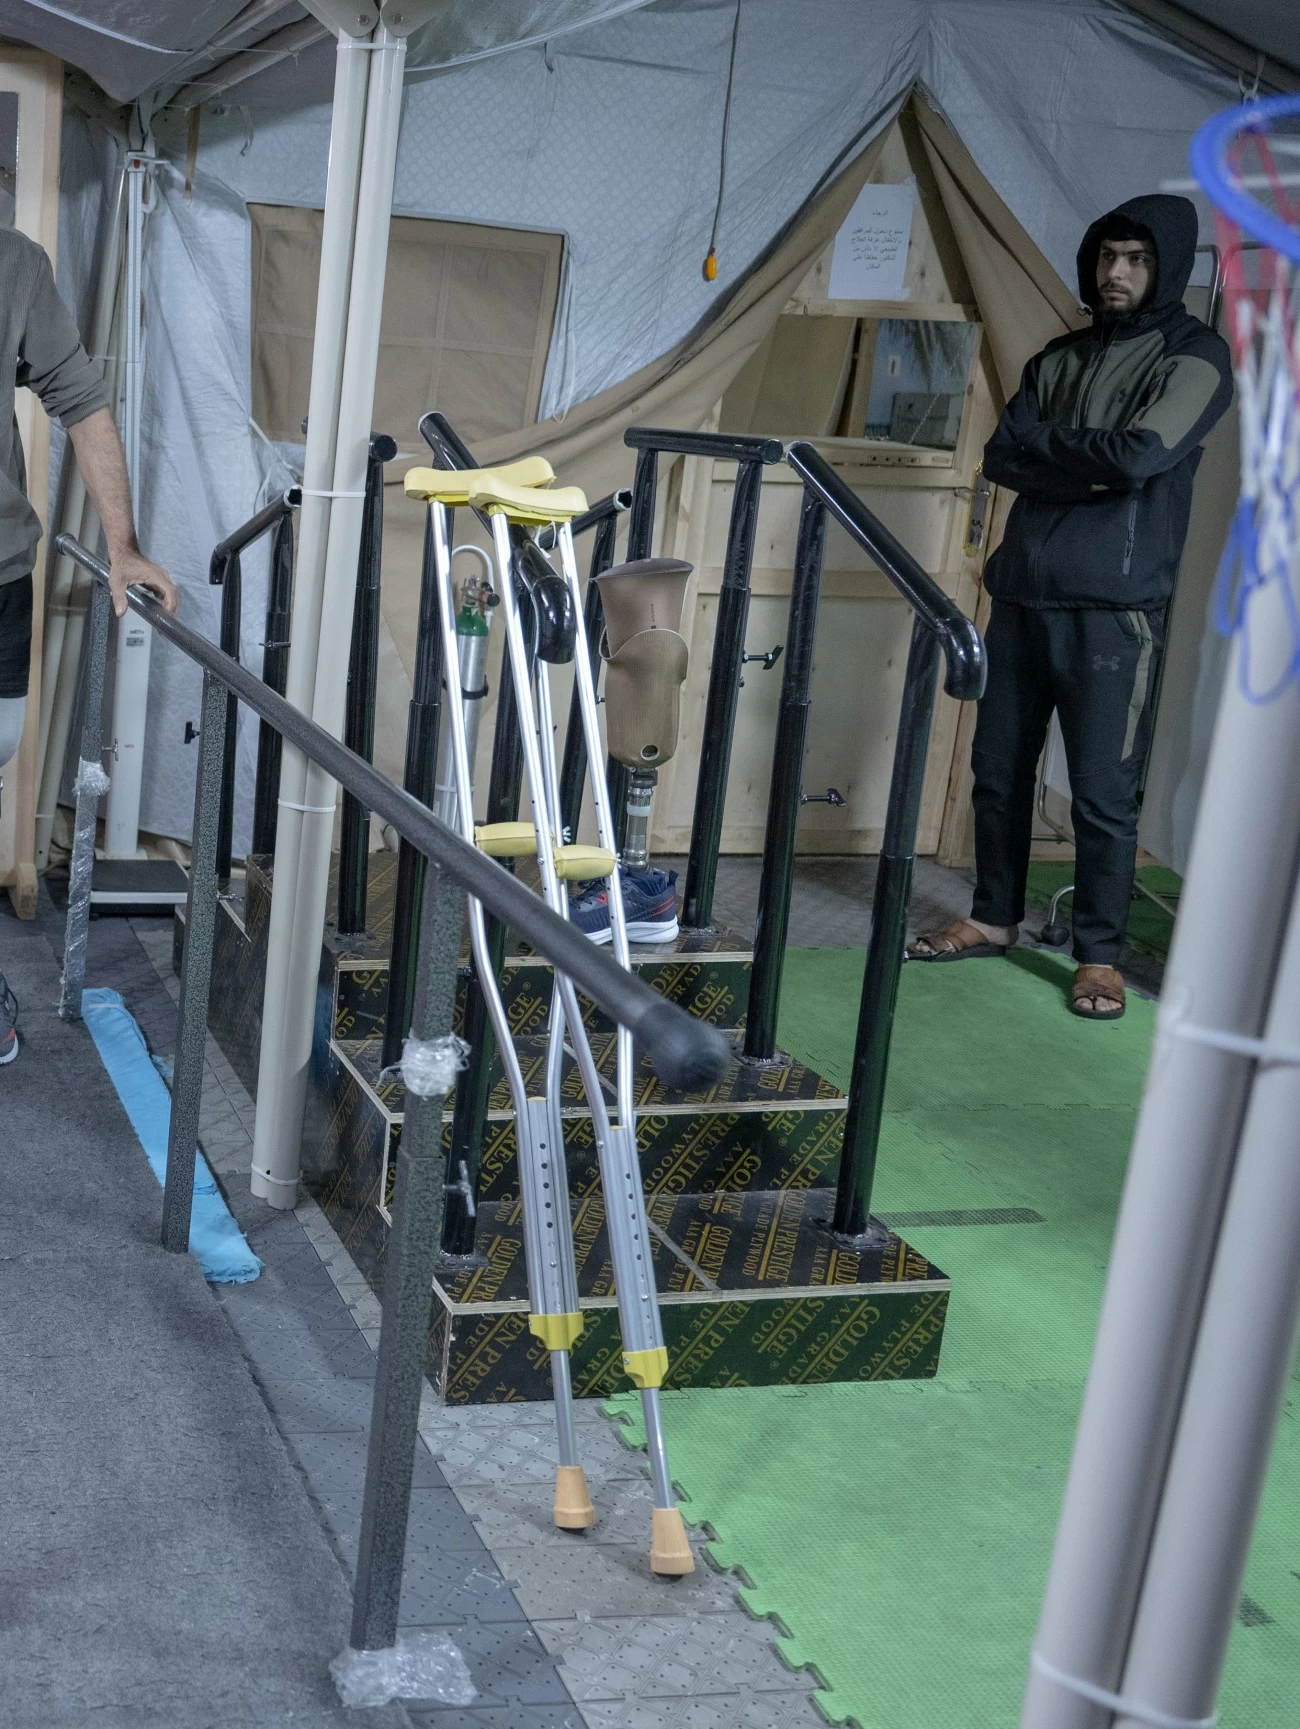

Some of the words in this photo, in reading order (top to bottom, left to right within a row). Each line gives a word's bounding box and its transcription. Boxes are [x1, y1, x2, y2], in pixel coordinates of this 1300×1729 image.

[666, 963, 701, 1004] GRAD
[716, 1142, 744, 1173] AAA
[789, 1111, 836, 1165] GRADE
[725, 1155, 762, 1192] GOL
[778, 1189, 807, 1229] GOLDEN
[482, 1238, 521, 1284] GOLDEN
[700, 1225, 733, 1271] GOLDEN
[743, 1232, 766, 1277] PLYWOOD
[767, 1298, 825, 1358] STIGE
[860, 1320, 911, 1378] PLYWO
[882, 1314, 944, 1380] PREST
[450, 1344, 503, 1402] PRES
[666, 1330, 726, 1389] PRES
